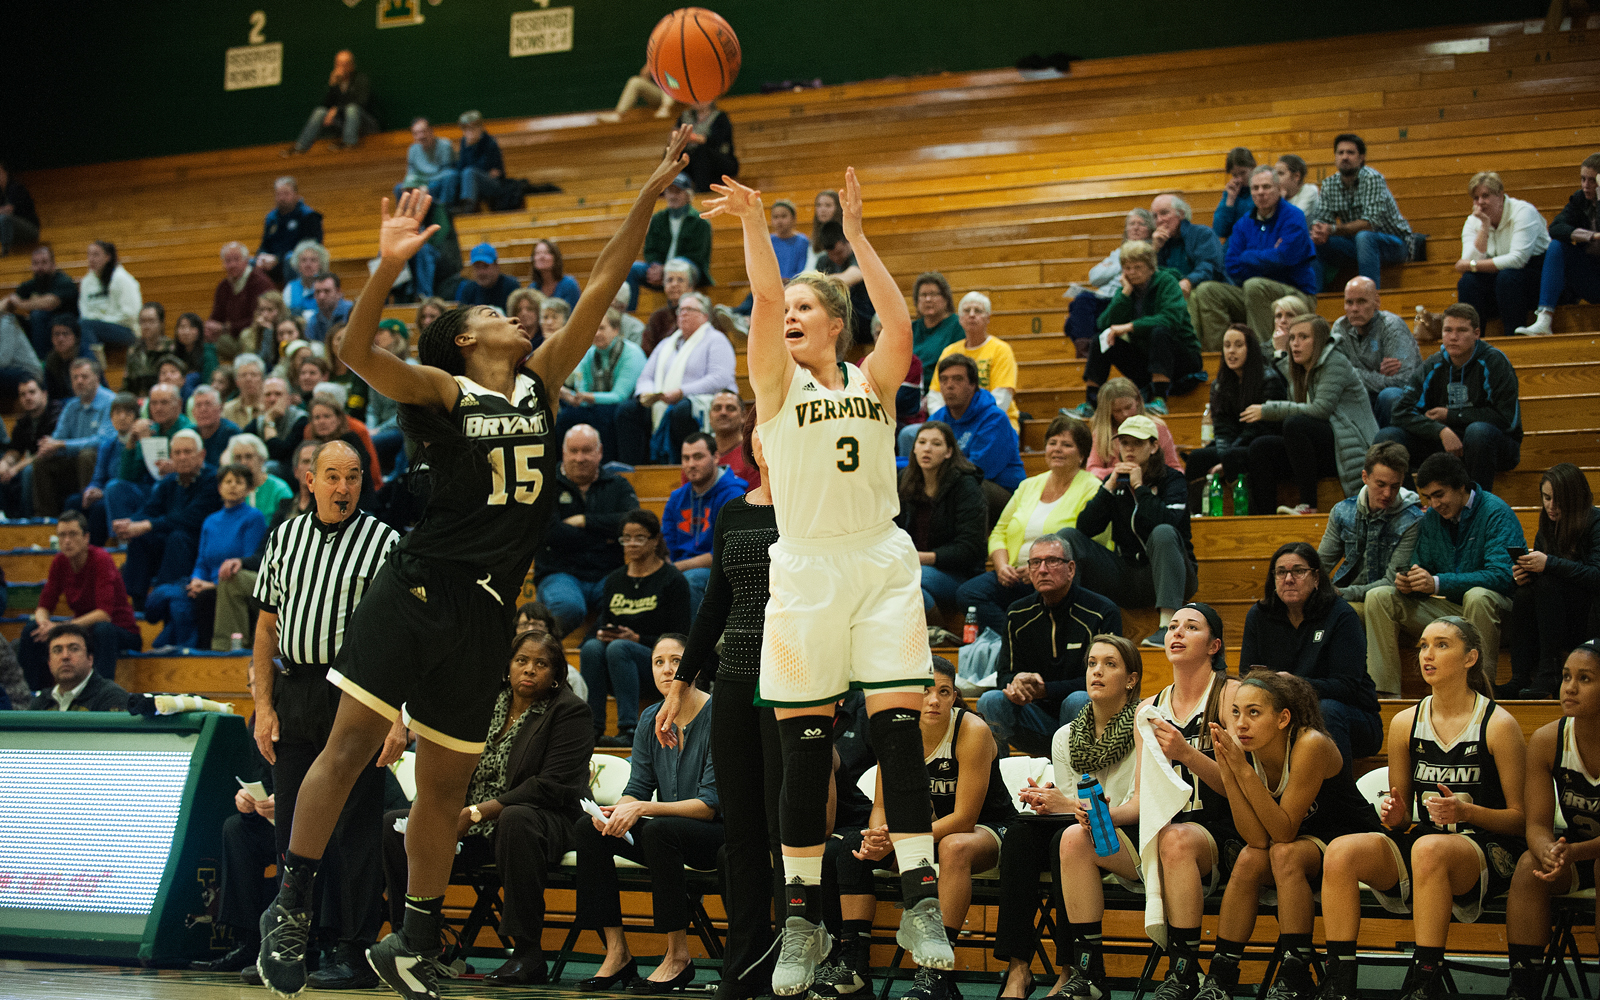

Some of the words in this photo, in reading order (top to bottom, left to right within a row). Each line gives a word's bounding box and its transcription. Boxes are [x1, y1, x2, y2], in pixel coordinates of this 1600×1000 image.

[249, 10, 266, 44] 2
[465, 414, 545, 438] BRYANT
[795, 396, 890, 429] VERMONT
[835, 436, 860, 474] 3
[486, 444, 545, 506] 15
